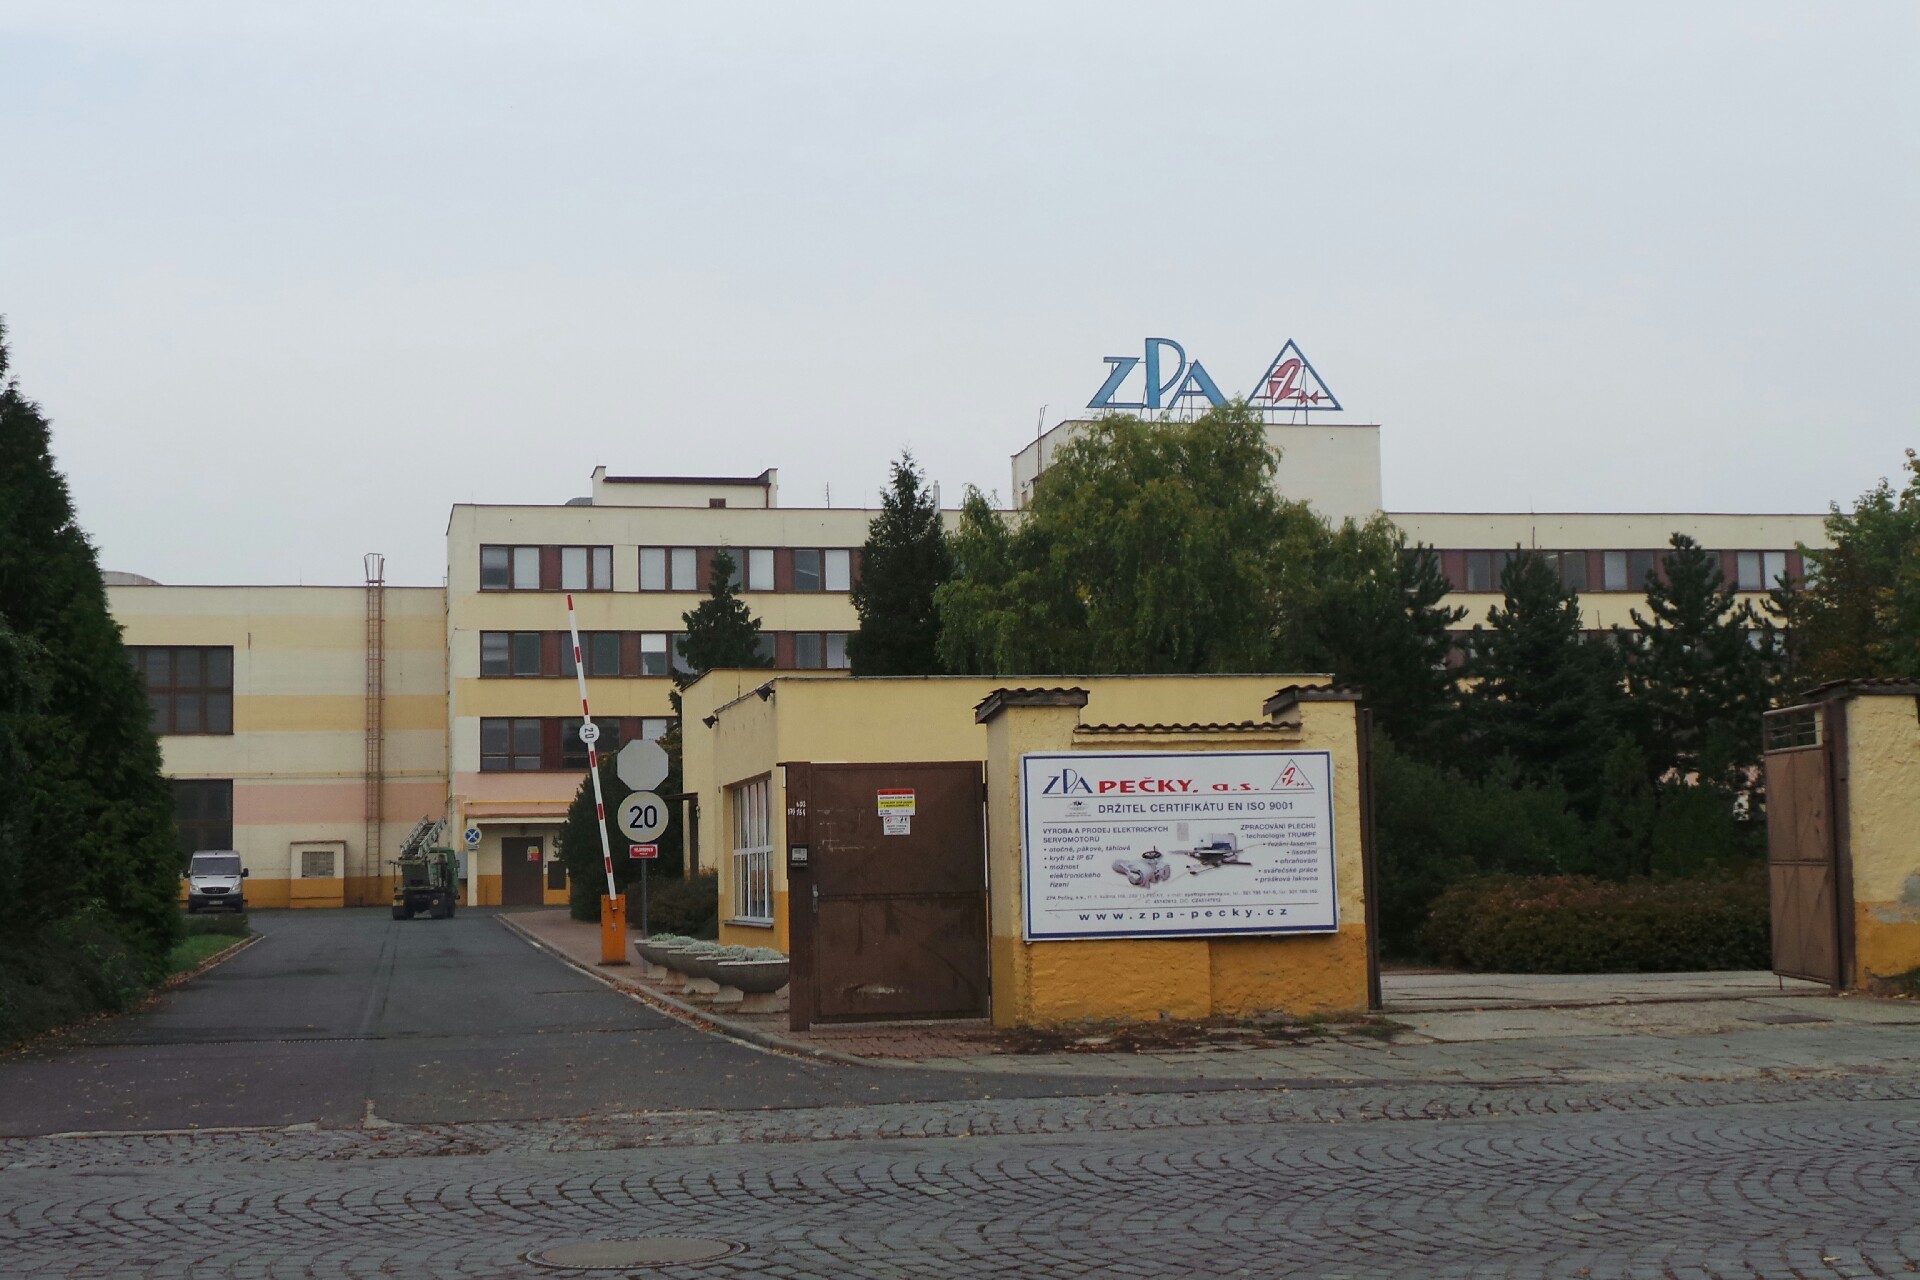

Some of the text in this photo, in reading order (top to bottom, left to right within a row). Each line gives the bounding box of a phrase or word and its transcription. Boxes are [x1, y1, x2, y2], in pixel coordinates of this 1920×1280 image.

[1086, 338, 1228, 409] ZPA
[585, 728, 594, 738] 20
[1042, 768, 1093, 795] ZPA
[1098, 802, 1293, 813] DRŽITEL CERTIFIKÁTU EN ISO 9001
[629, 805, 658, 829] 20
[1079, 908, 1287, 921] www.zpa-pecky.cz
